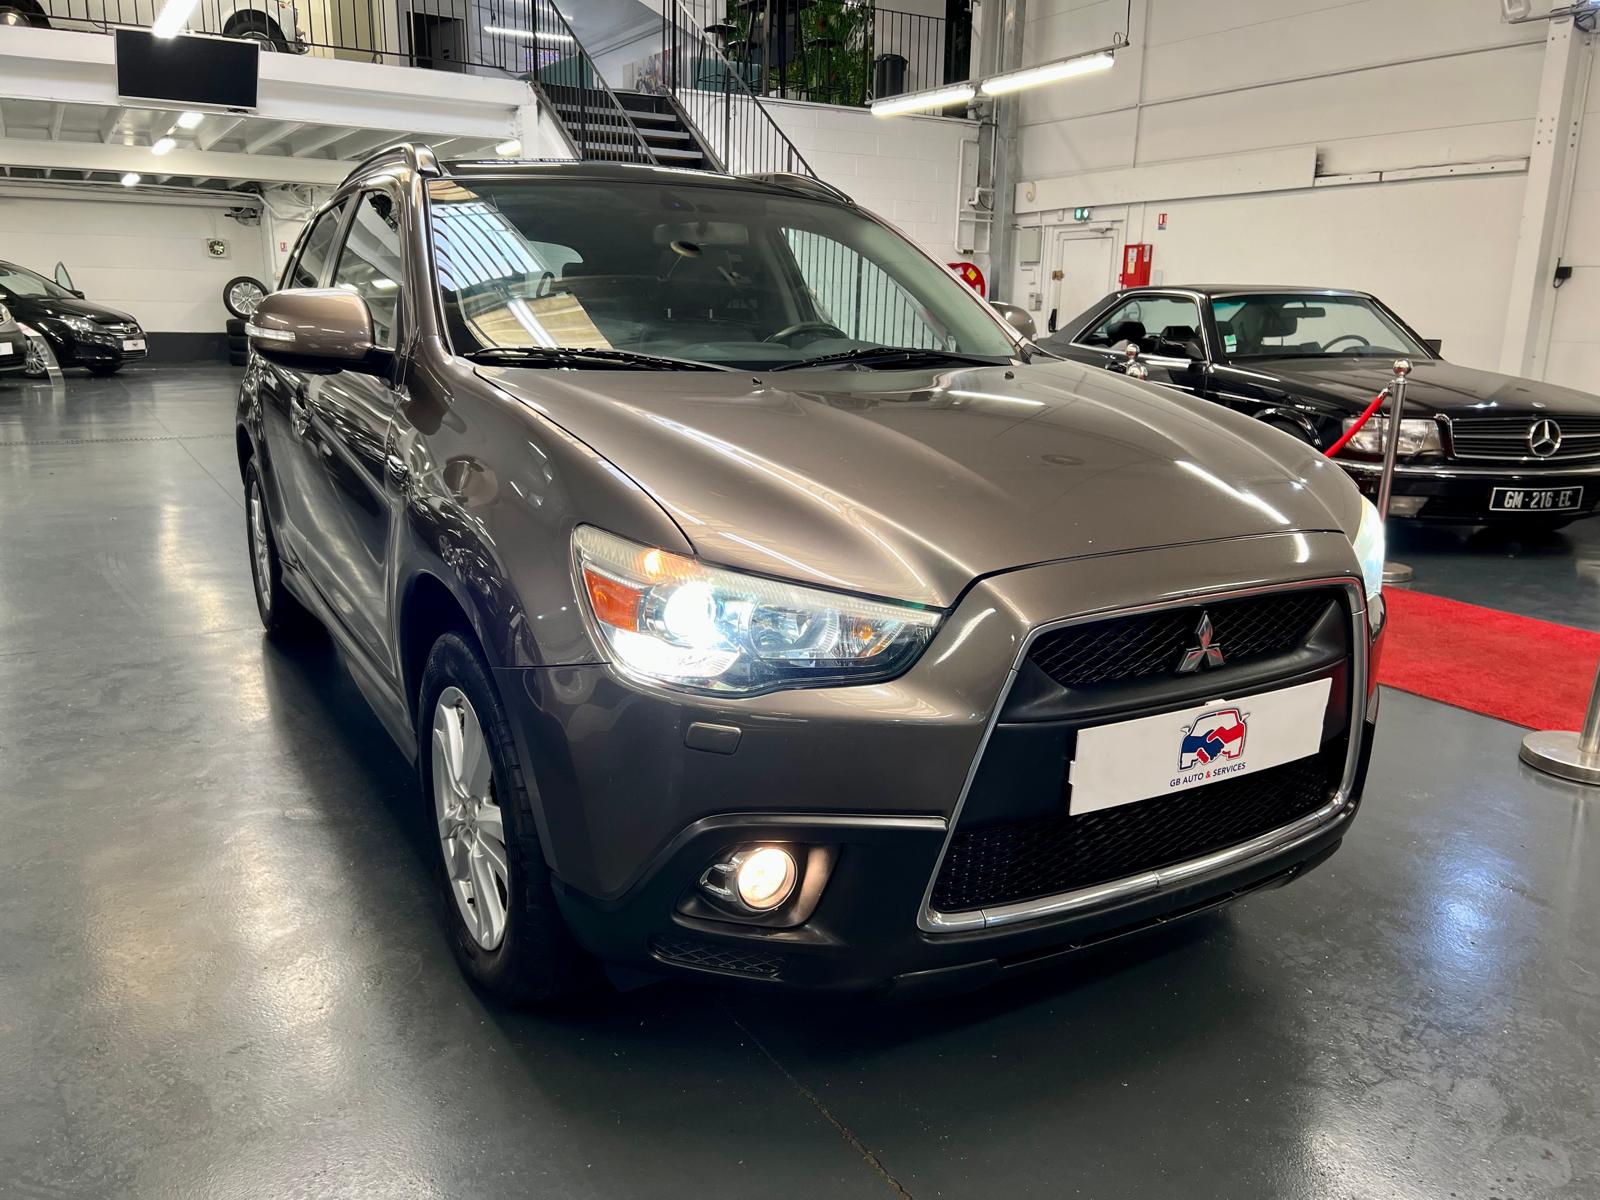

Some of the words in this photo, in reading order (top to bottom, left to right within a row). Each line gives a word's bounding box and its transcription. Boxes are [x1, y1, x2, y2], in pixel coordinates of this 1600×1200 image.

[1169, 778, 1181, 787] GB
[1182, 772, 1204, 784] AUTO
[1205, 770, 1211, 779] &
[1212, 761, 1246, 777] SERVICES
